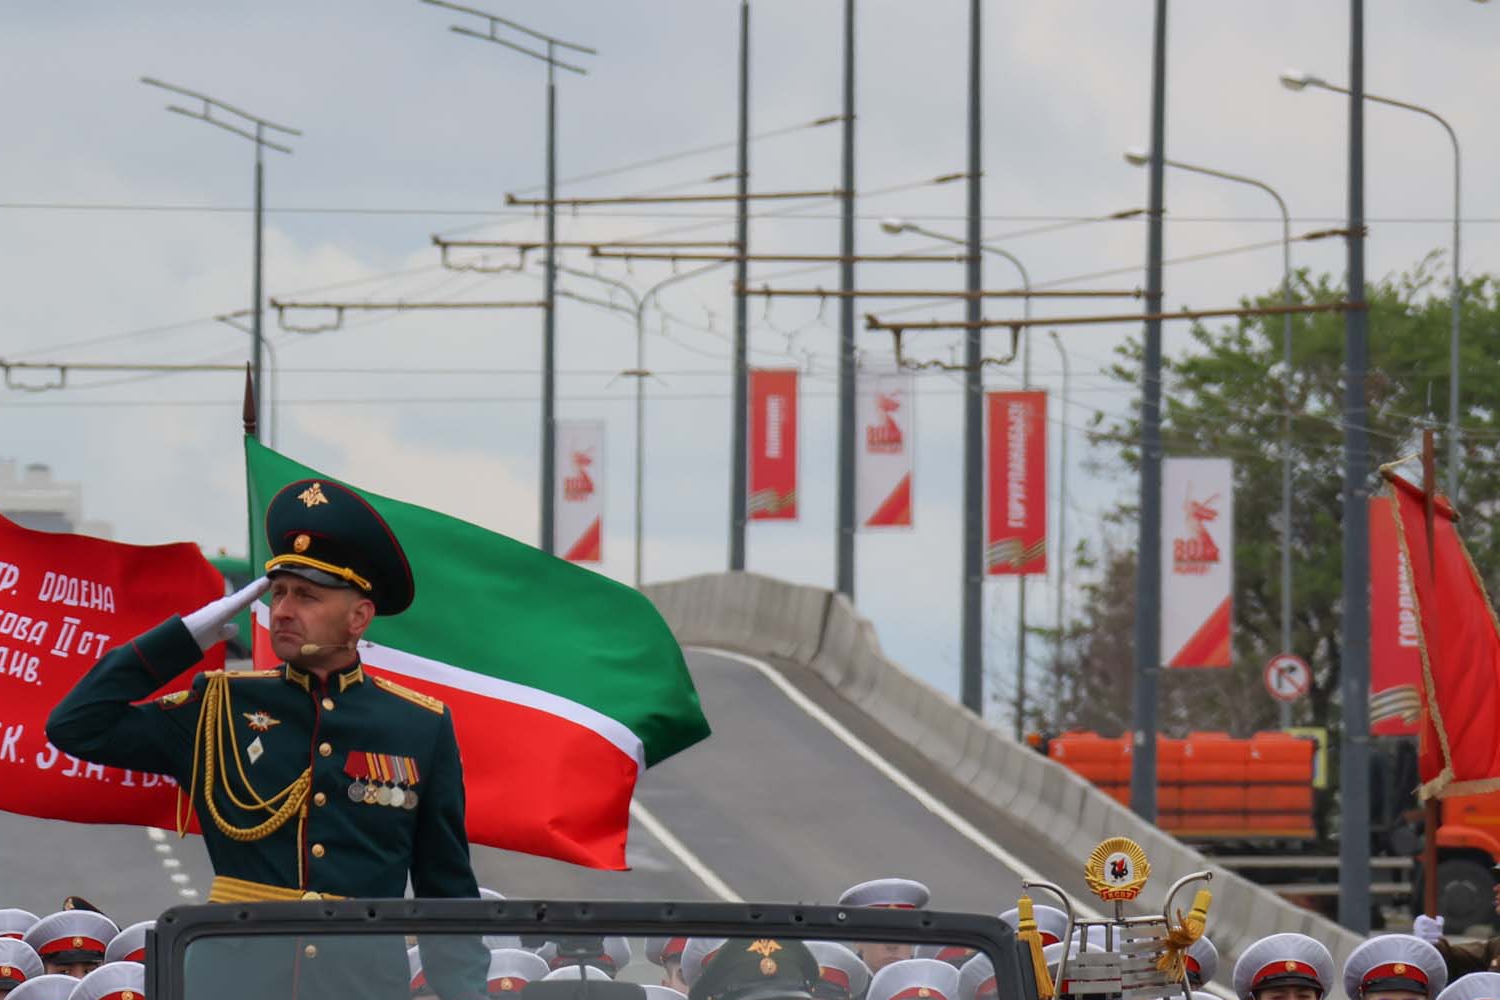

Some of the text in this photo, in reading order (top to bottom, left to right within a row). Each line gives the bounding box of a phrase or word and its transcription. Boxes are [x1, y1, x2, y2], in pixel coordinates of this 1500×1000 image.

[38, 571, 116, 614] ОРДЕНА
[50, 616, 81, 658] II
[77, 631, 111, 659] СТ
